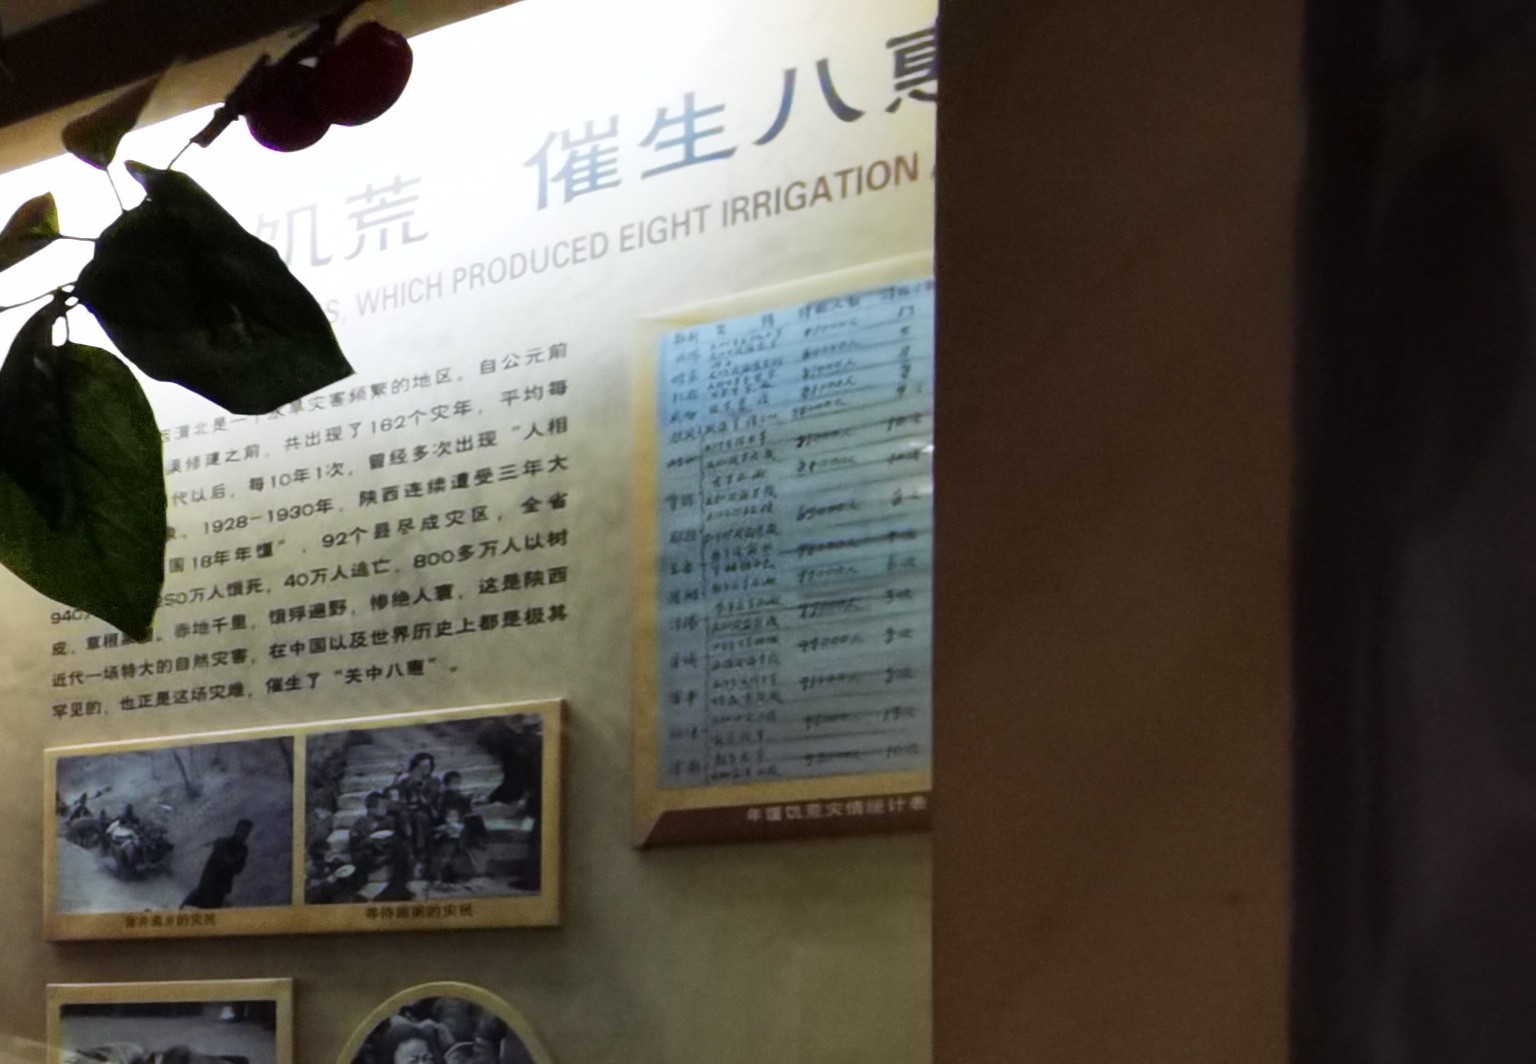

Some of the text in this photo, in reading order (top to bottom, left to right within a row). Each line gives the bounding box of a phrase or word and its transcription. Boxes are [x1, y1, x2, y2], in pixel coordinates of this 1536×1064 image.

[354, 273, 445, 319] WHICH
[451, 231, 610, 295] PRODUCED
[618, 204, 713, 253] EIGHT
[721, 151, 921, 229] IRRIGATION
